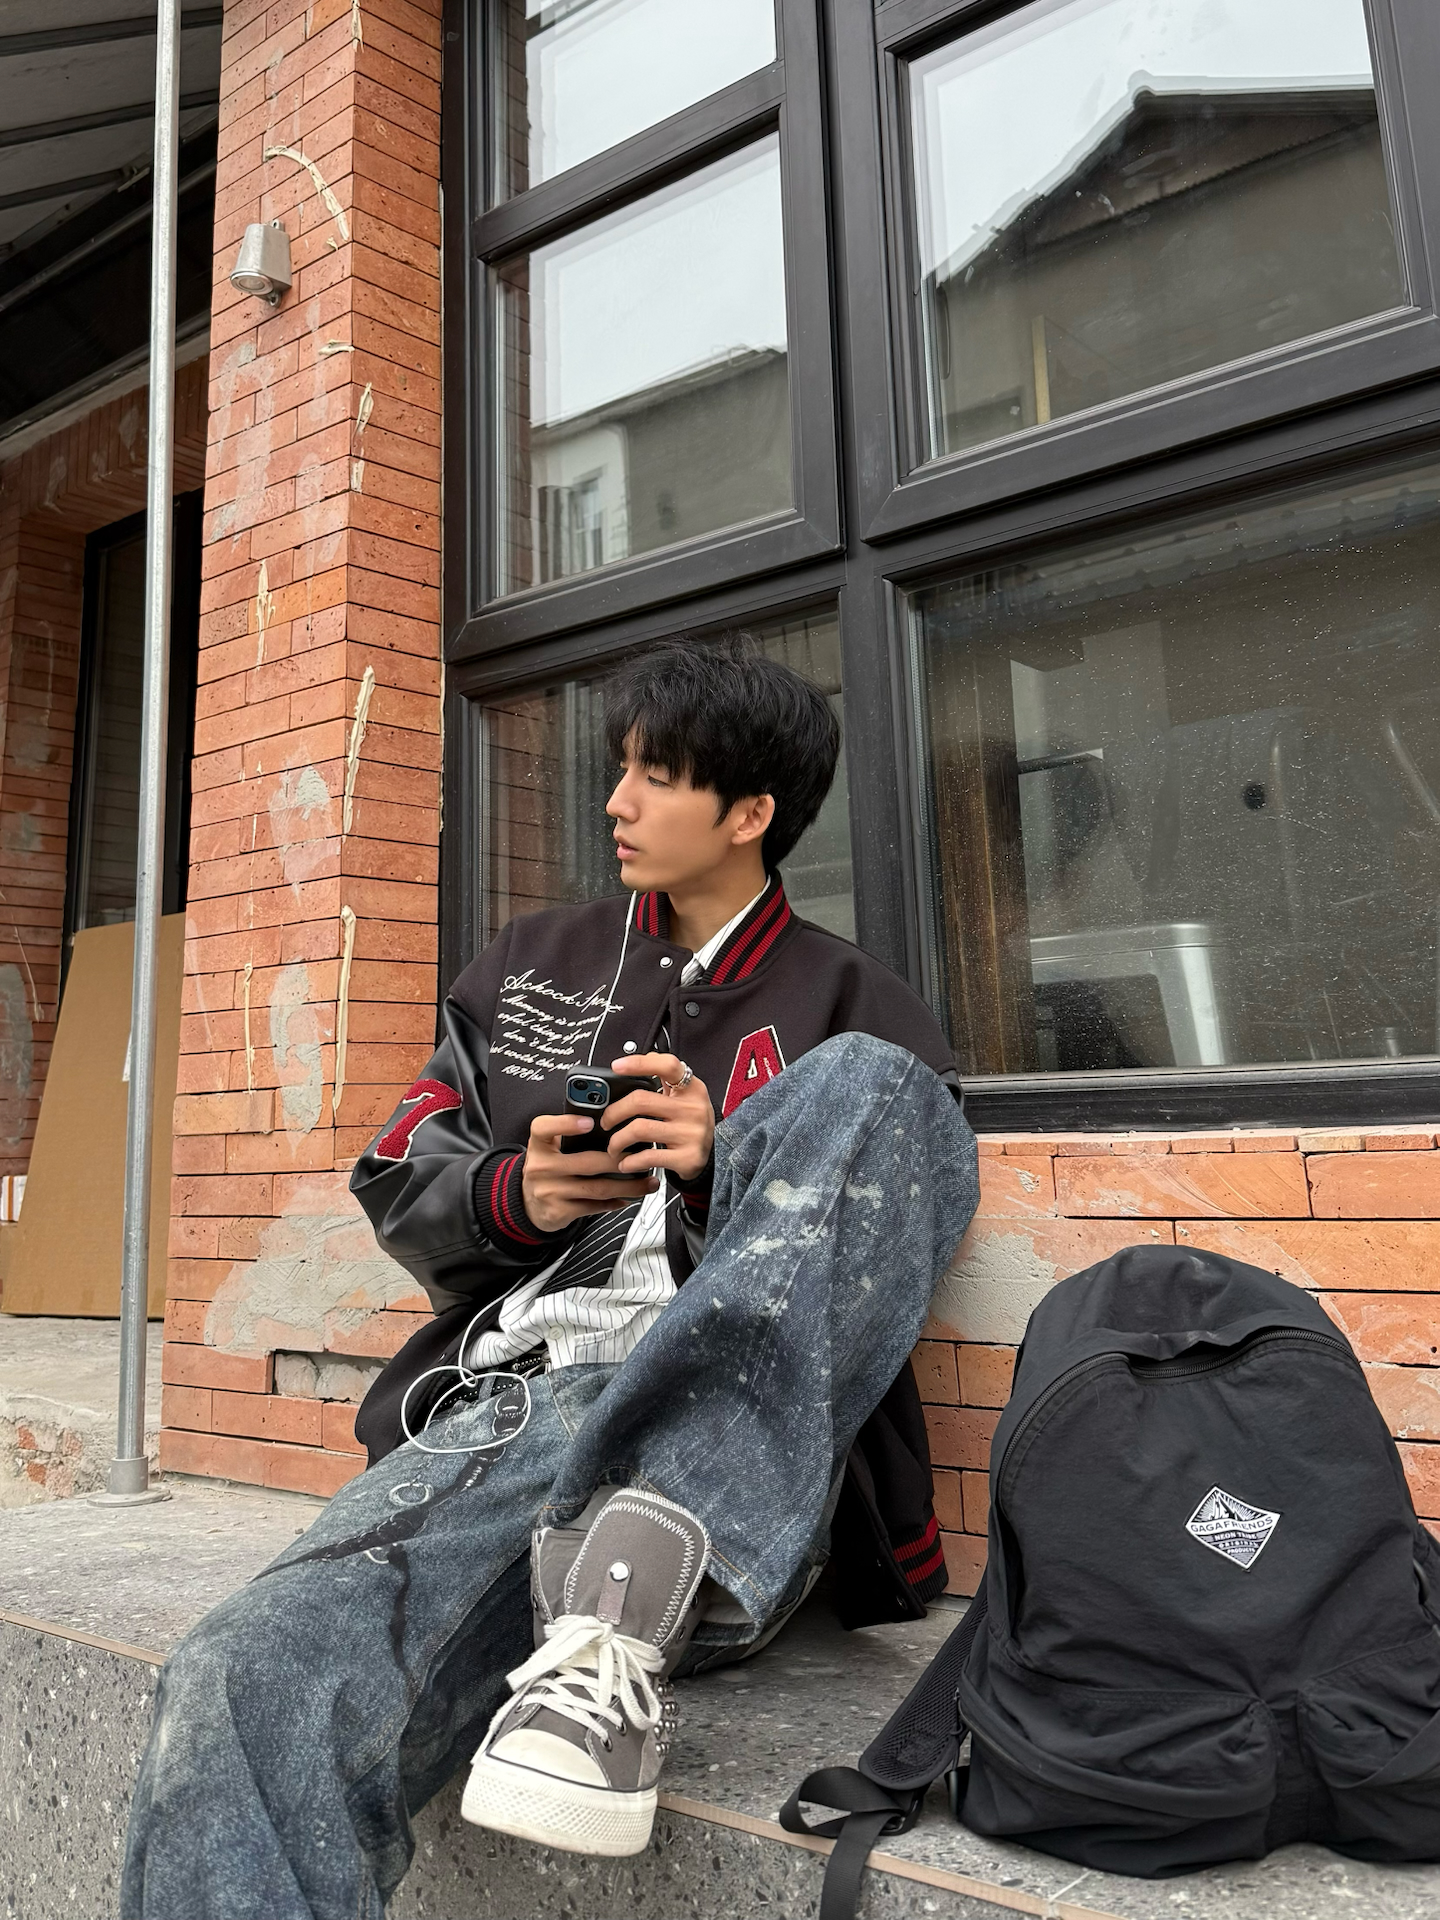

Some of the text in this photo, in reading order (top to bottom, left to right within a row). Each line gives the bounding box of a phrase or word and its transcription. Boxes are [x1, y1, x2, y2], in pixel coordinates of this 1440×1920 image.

[502, 993, 555, 1022] Memory
[1190, 1516, 1273, 1533] GAGAFRIENDS
[1214, 1532, 1237, 1541] NEON
